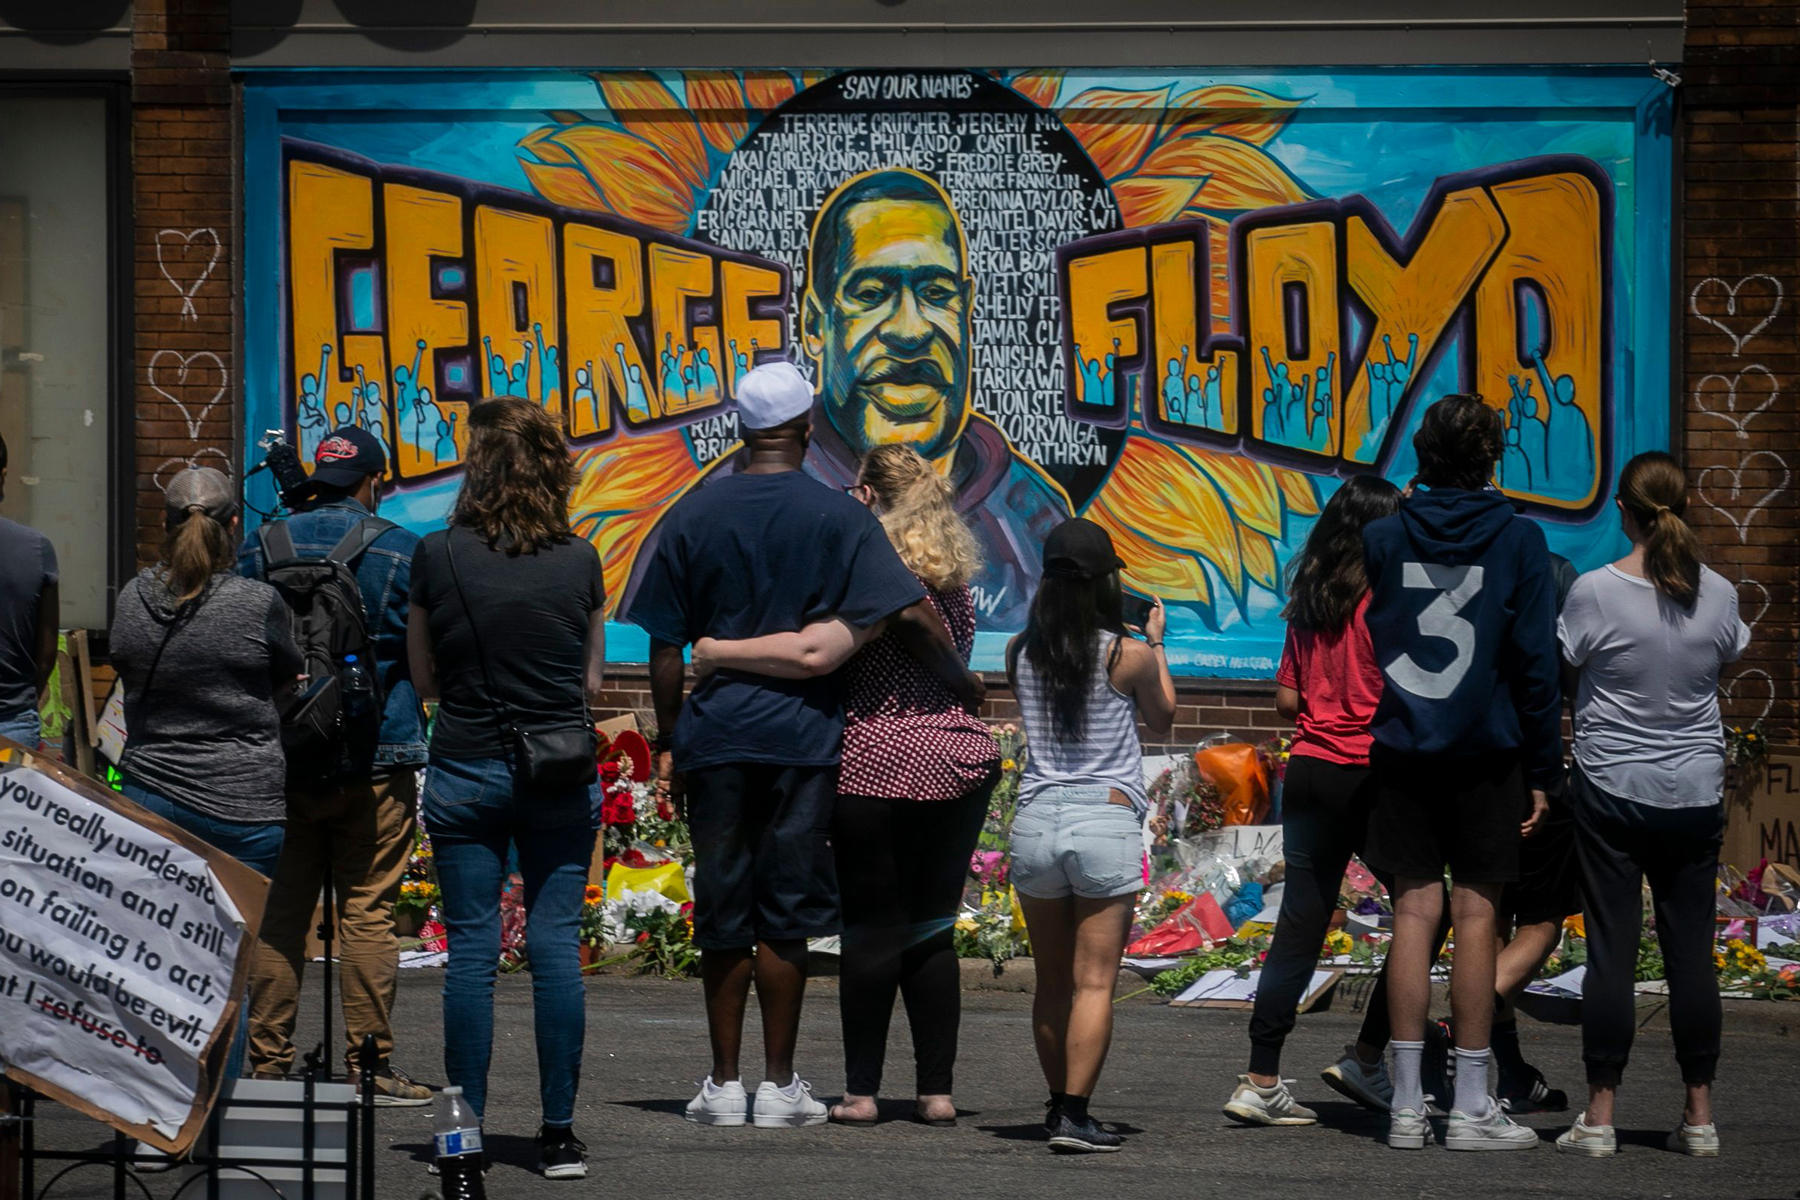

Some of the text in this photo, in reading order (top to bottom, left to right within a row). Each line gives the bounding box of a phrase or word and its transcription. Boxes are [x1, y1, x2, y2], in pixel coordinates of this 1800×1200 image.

[843, 75, 972, 99] SAY OUR NAMES
[780, 113, 868, 135] TERRENCE
[871, 112, 951, 135] CRUTCHER
[957, 113, 1028, 135] JEREMY
[758, 133, 1042, 154] TAMIR RICE PHILANDO CASTILE
[728, 151, 1063, 174] AKAI GURLEY KENDRA JAMES FREDDIE GREY
[721, 170, 793, 188] MICHAEL
[937, 171, 1080, 190] TERRANCE FRANKLIN
[709, 189, 767, 211] TYISHA
[950, 188, 1115, 212] BREONNA TAYLOR AL
[697, 210, 808, 231] ERIC GARNER
[960, 209, 1035, 231] SHANTEL
[1035, 210, 1083, 231] DAVIS
[708, 229, 776, 250] SANDRA
[965, 230, 1033, 252] WALTER
[968, 250, 1016, 274] REKIA
[973, 295, 1033, 320] SHELLY
[287, 159, 784, 482] GEORGE
[971, 319, 1031, 345] JAMAR
[1068, 172, 1602, 503] FLOYD
[972, 345, 1047, 369] TANISHA
[973, 368, 1037, 391] TARIKA
[973, 389, 1064, 415] ALTON STE
[1020, 441, 1107, 466] KATHRYN
[1385, 562, 1484, 699] 3
[1, 776, 43, 811] you
[44, 800, 115, 854] really
[2, 827, 225, 957] situation and still
[0, 878, 215, 1005] on failing to act,
[28, 943, 111, 995] would
[114, 978, 146, 1015] be
[150, 1008, 202, 1047] evil.
[24, 981, 36, 1004] I
[39, 993, 127, 1048] refuse
[134, 1035, 163, 1065] to
